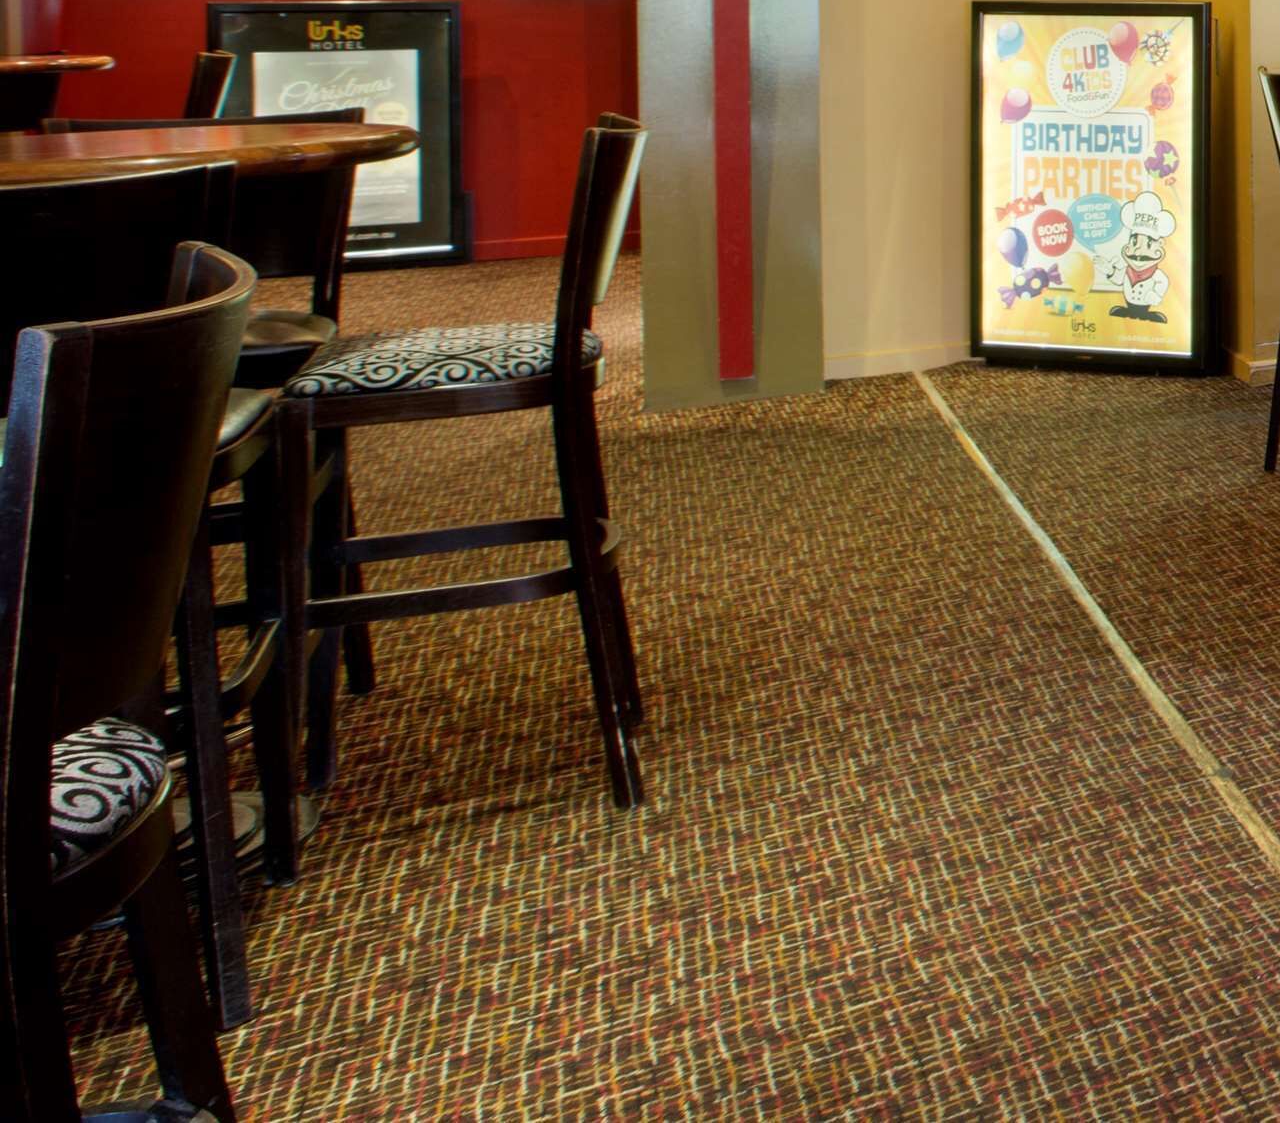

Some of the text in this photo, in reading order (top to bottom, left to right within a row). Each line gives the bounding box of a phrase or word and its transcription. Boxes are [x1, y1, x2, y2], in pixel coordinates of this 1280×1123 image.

[310, 41, 365, 50] HOTEL
[1062, 44, 1109, 71] CLUB
[1022, 123, 1142, 154] BIRTHDAY
[1023, 157, 1144, 200] PARTIES
[1134, 213, 1159, 225] PEPE
[1038, 223, 1068, 236] BOOK
[1041, 233, 1067, 247] NOW
